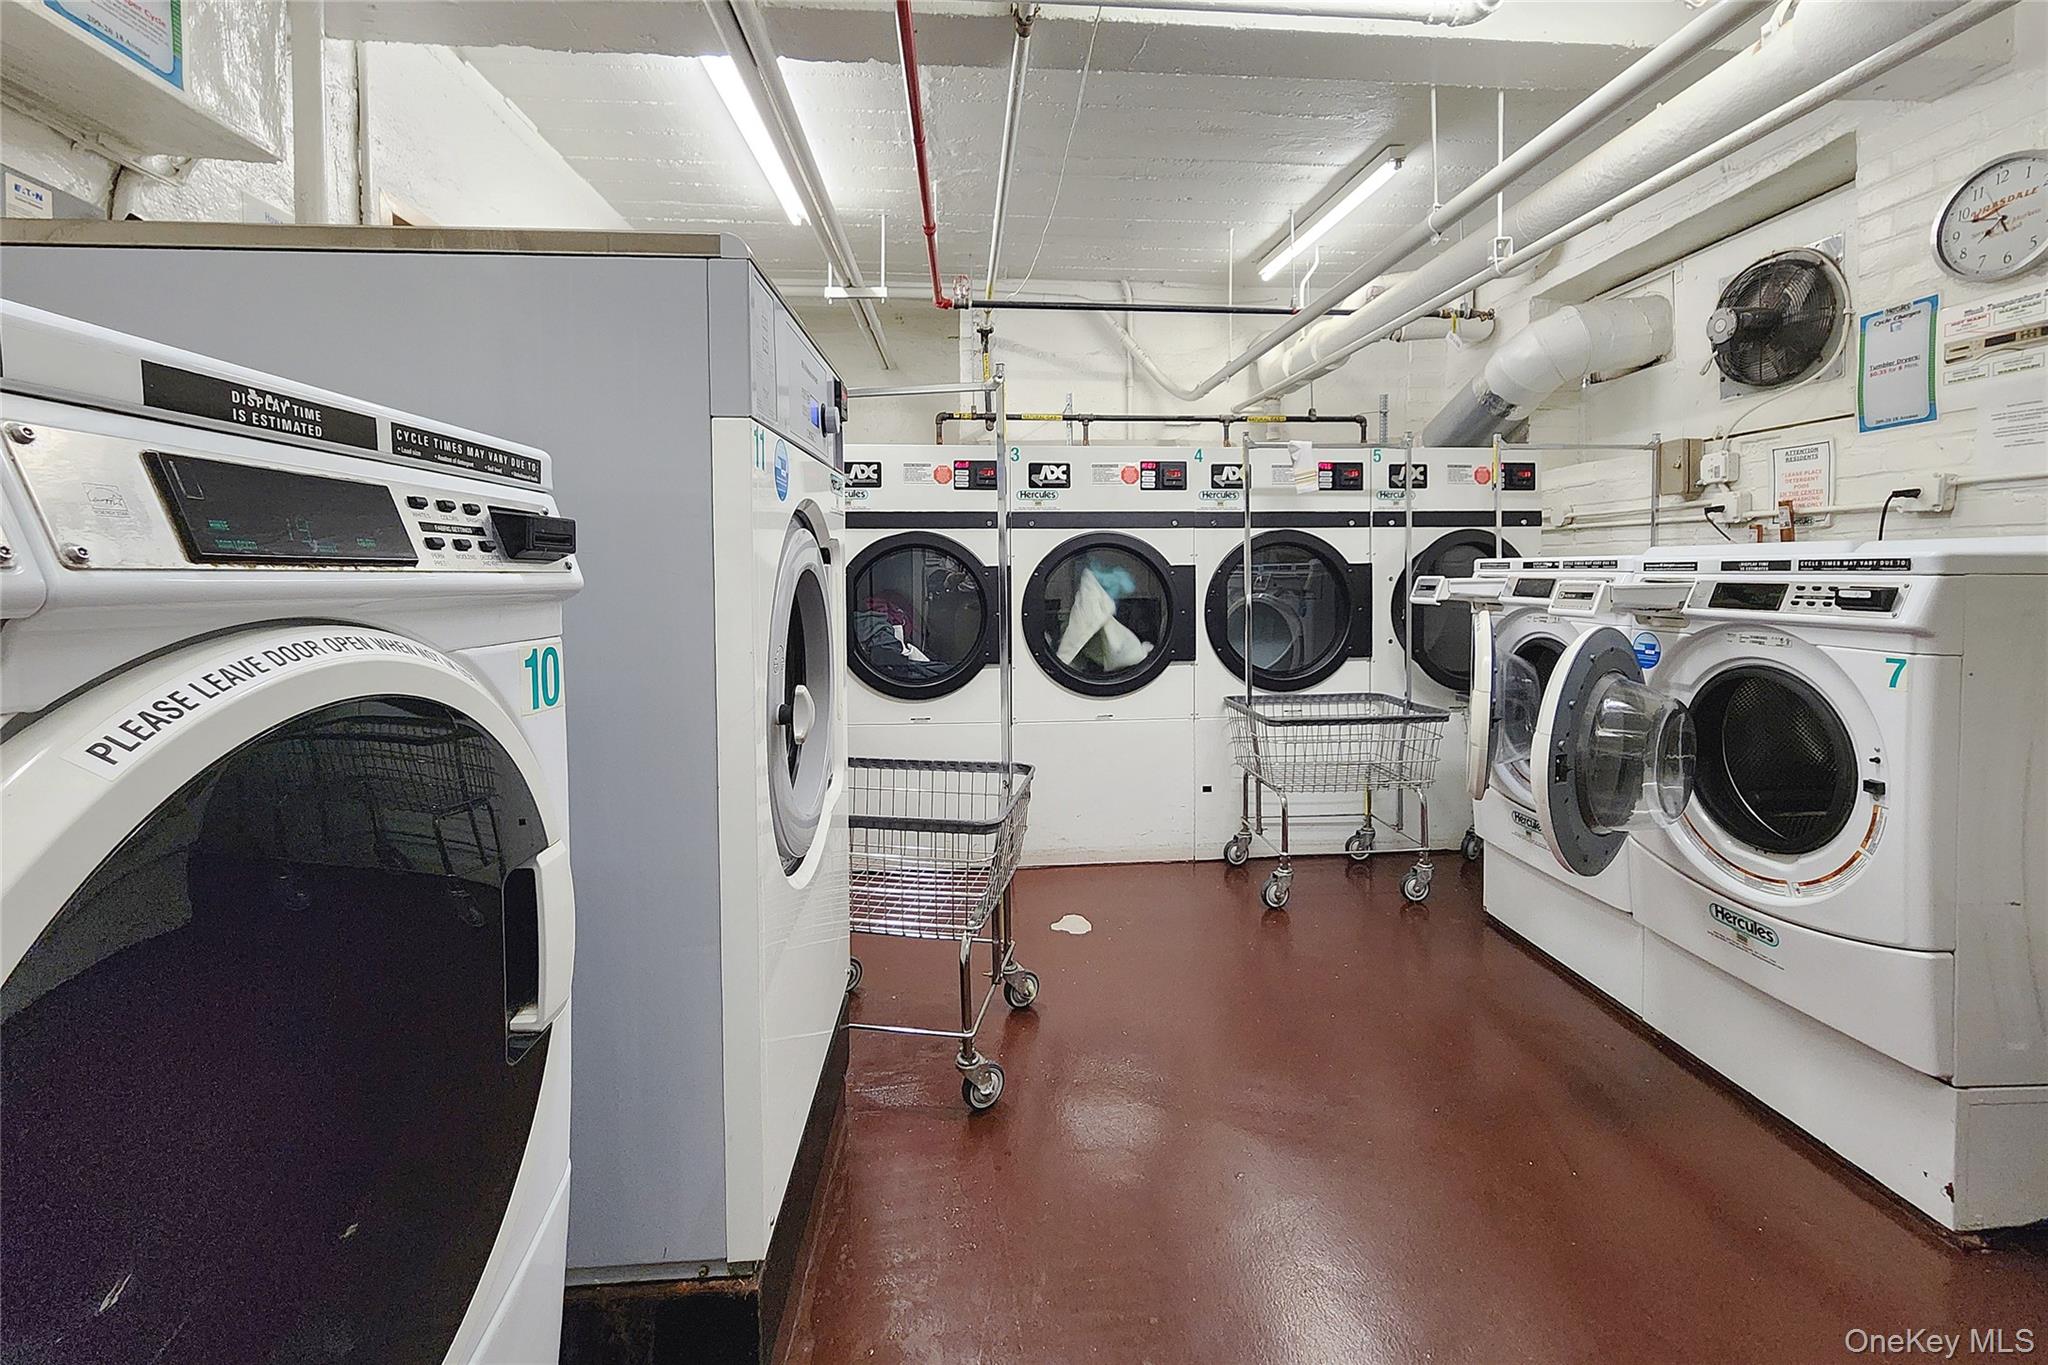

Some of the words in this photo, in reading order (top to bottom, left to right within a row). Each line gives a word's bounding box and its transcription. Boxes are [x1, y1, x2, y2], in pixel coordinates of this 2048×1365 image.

[144, 9, 166, 28] Cycle
[1996, 170, 2010, 185] 12
[2026, 166, 2031, 178] 1
[1973, 186, 1984, 201] 11
[1959, 207, 1970, 221] 10
[1953, 232, 1960, 244] 9
[2030, 235, 2037, 249] 5
[1960, 248, 1967, 259] 8
[2003, 251, 2011, 264] 6
[1978, 255, 1986, 268] 7
[1873, 318, 1892, 327] Cycle
[1893, 310, 1921, 321] Charges
[1870, 362, 1895, 371] Tumbler
[231, 389, 290, 414] DISPLAY
[293, 405, 322, 422] TIME
[232, 408, 246, 422] IS
[252, 412, 323, 437] ESTIMATED
[396, 429, 430, 447] CYCLE
[433, 438, 463, 454] TIMES
[466, 446, 485, 459] MAY
[487, 452, 509, 464] VARY
[510, 457, 525, 469] DUE
[754, 426, 765, 471] 11
[1011, 448, 1020, 462] 3
[1194, 449, 1203, 462] 4
[1373, 449, 1381, 462] 5
[1785, 447, 1818, 456] ATTENTION
[1785, 454, 1818, 463] RESIDENTS
[850, 464, 878, 479] ADC
[1040, 465, 1067, 480] ADC
[1785, 476, 1818, 484] DETERGENT
[1020, 491, 1056, 499] Hercules
[524, 646, 560, 710] 10
[1885, 658, 1907, 688] 7
[86, 690, 200, 766] PLEASE
[188, 656, 271, 699] LEAVE
[262, 640, 328, 667] DOOR
[322, 636, 373, 652] OPEN
[369, 637, 420, 657] WHEN
[417, 646, 445, 662] NOT
[1514, 812, 1542, 832] Hercule
[1714, 904, 1774, 943] Hercules
